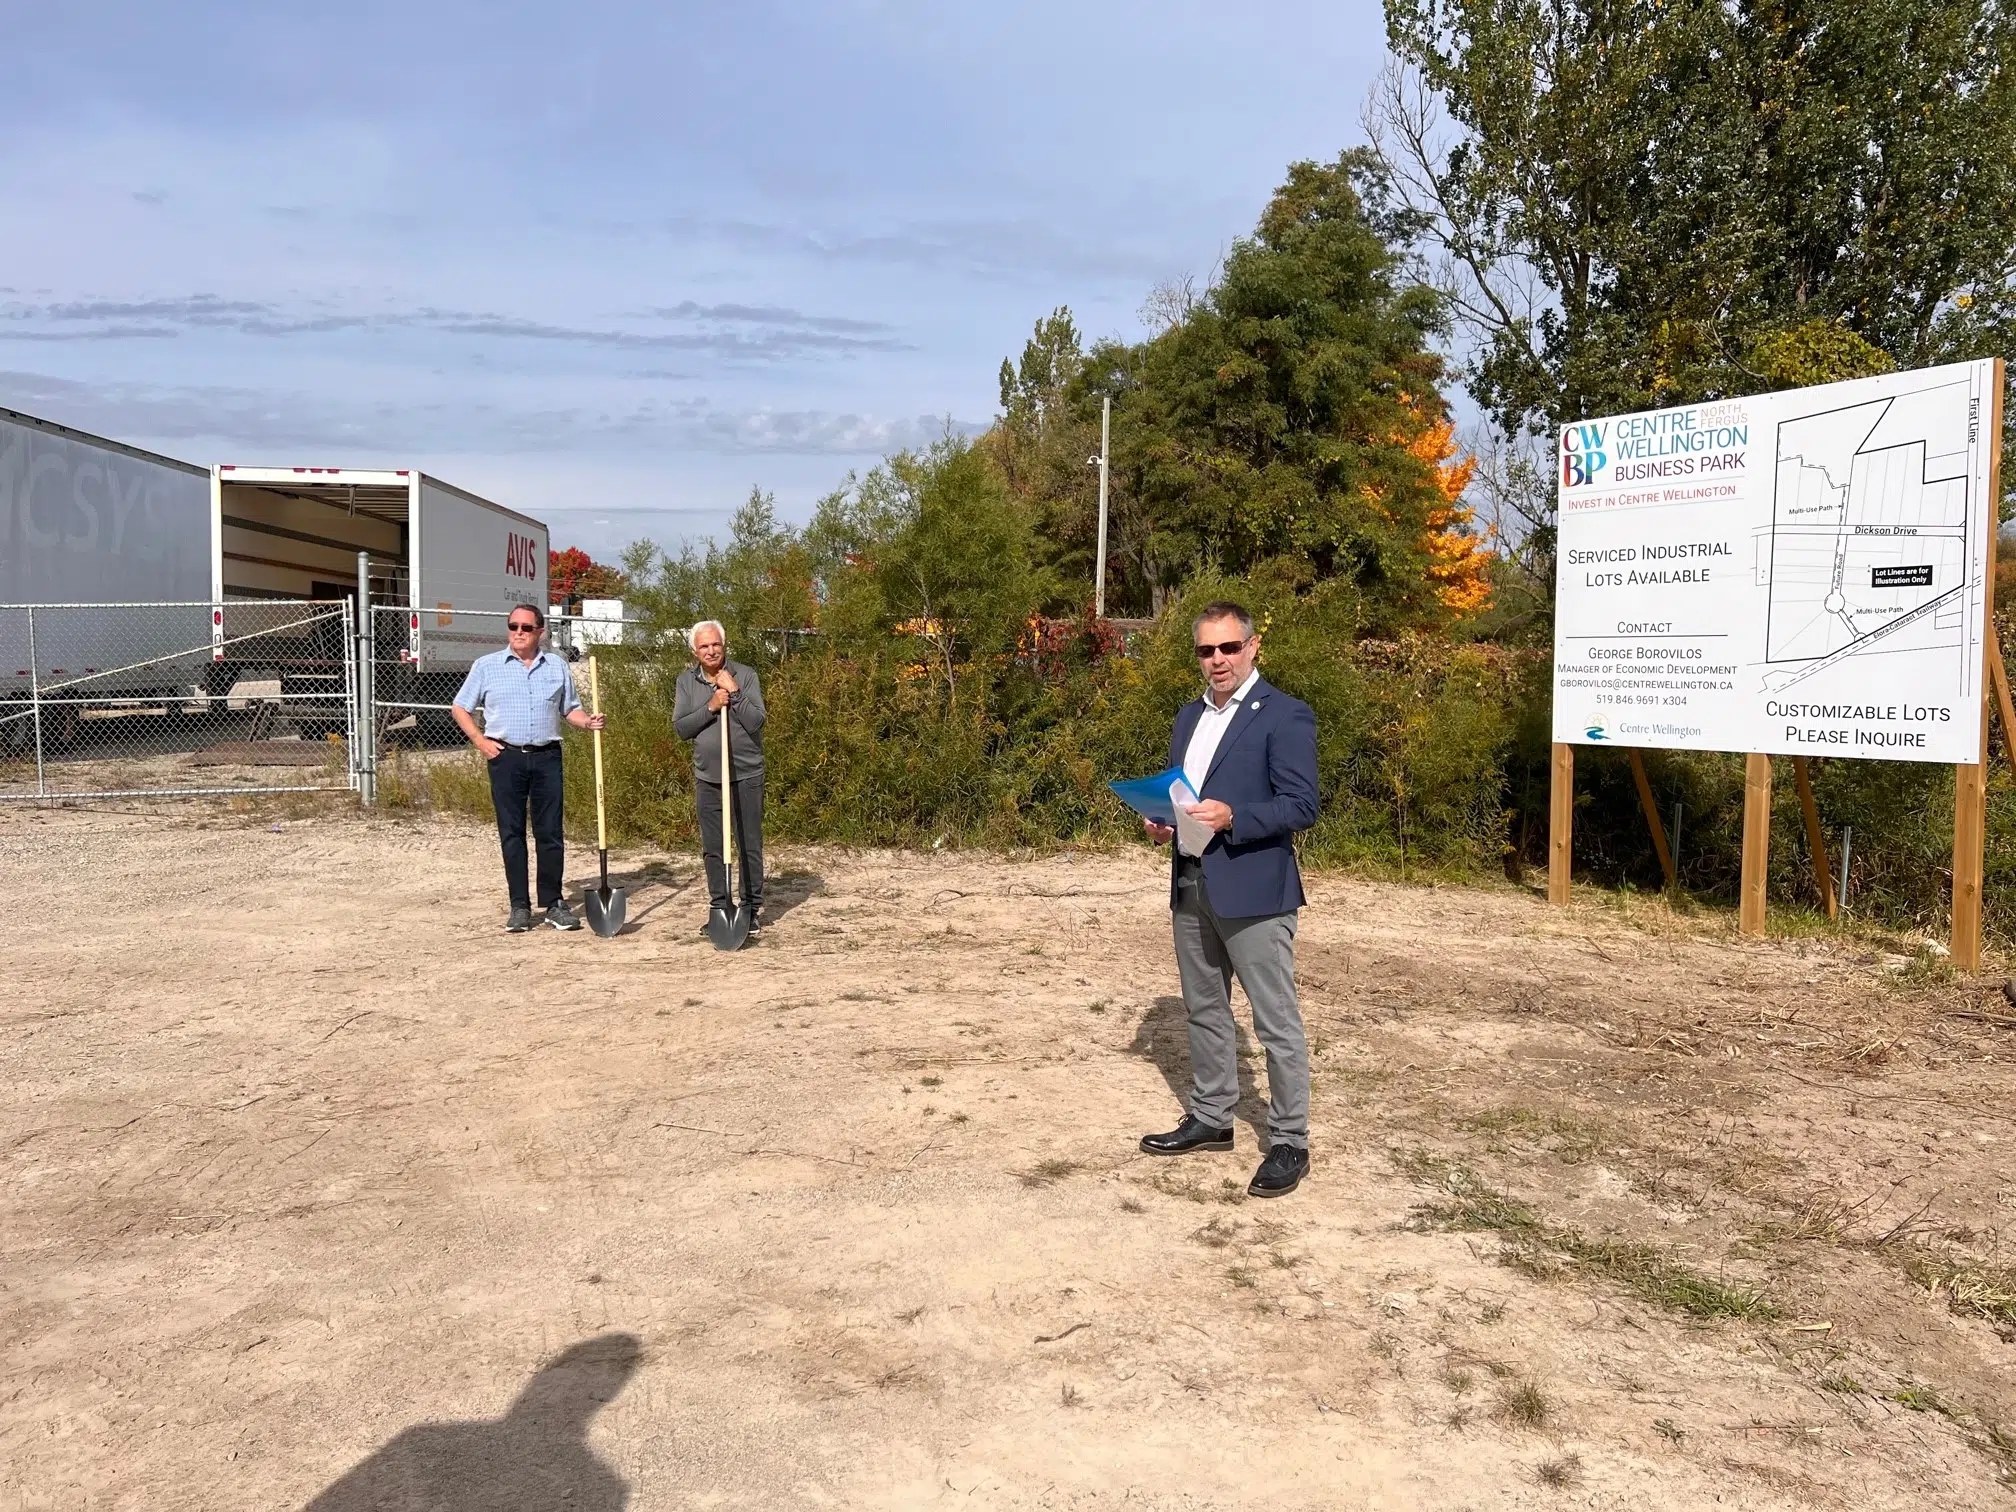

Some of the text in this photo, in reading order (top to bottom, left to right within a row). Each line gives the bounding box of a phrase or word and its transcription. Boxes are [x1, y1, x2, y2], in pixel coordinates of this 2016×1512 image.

[1701, 404, 1742, 418] NORTH
[1616, 410, 1697, 439] CENTRE
[1700, 413, 1748, 429] FERGUS
[1969, 398, 1979, 443] First Line
[1563, 422, 1609, 453] CW
[1616, 425, 1748, 460] WELLINGTON
[1563, 451, 1607, 488] BP
[1615, 452, 1746, 482] BUSINESS PARK
[1568, 498, 1603, 510] INVEST
[1618, 493, 1660, 506] CENTRE
[1663, 485, 1736, 501] WELLINGTON
[1788, 504, 1833, 515] Multi-Use Path
[1854, 526, 1918, 535] Dickson Drive
[505, 532, 536, 581] AVIS
[1568, 542, 1733, 564] SERVICED INDUSTRIAL
[1586, 569, 1710, 587] LOTS AVAILABLE
[1875, 569, 1886, 577] Lot
[1887, 568, 1905, 576] Lines
[1918, 566, 1929, 574] for
[1875, 576, 1927, 585] Illustration Only
[1856, 607, 1887, 615] Multi-Use
[1873, 600, 1942, 639] Elora-Cataract Trailway
[1617, 621, 1673, 633] CONTACT
[1588, 647, 1702, 659] GEORGE BOROVILOS
[1557, 664, 1738, 675] MANAGER OF ECONOMIC DEVELOPMENT
[1596, 695, 1687, 706] 519.846.9691 x304
[1766, 700, 1951, 722] CUSTOMIZABLE LOTS
[1619, 723, 1701, 739] Centre Wellington
[1786, 726, 1926, 748] PLEASE INQUIRE
